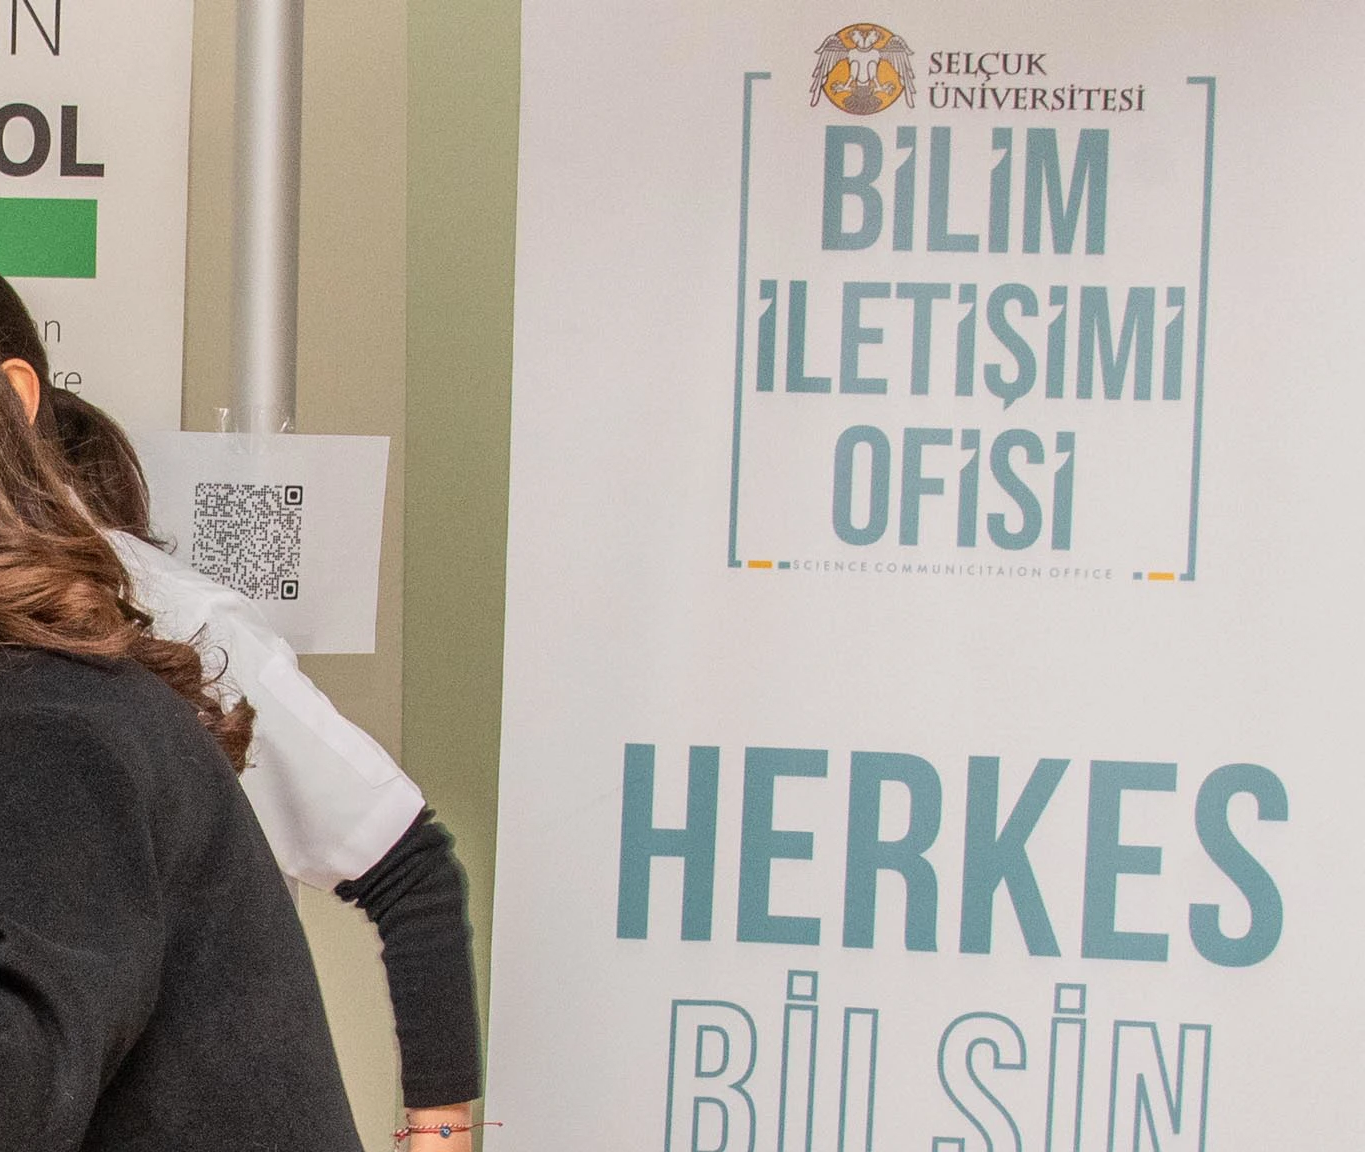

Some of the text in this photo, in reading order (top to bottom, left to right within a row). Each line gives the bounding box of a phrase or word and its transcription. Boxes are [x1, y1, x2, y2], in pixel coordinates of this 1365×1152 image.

[928, 51, 1047, 82] SELÇUK
[928, 82, 1146, 113] ÜNİVERSİTESİ
[793, 560, 868, 572] SCIENCE
[1049, 567, 1113, 580] OFFICE
[616, 742, 1289, 968] HERKES
